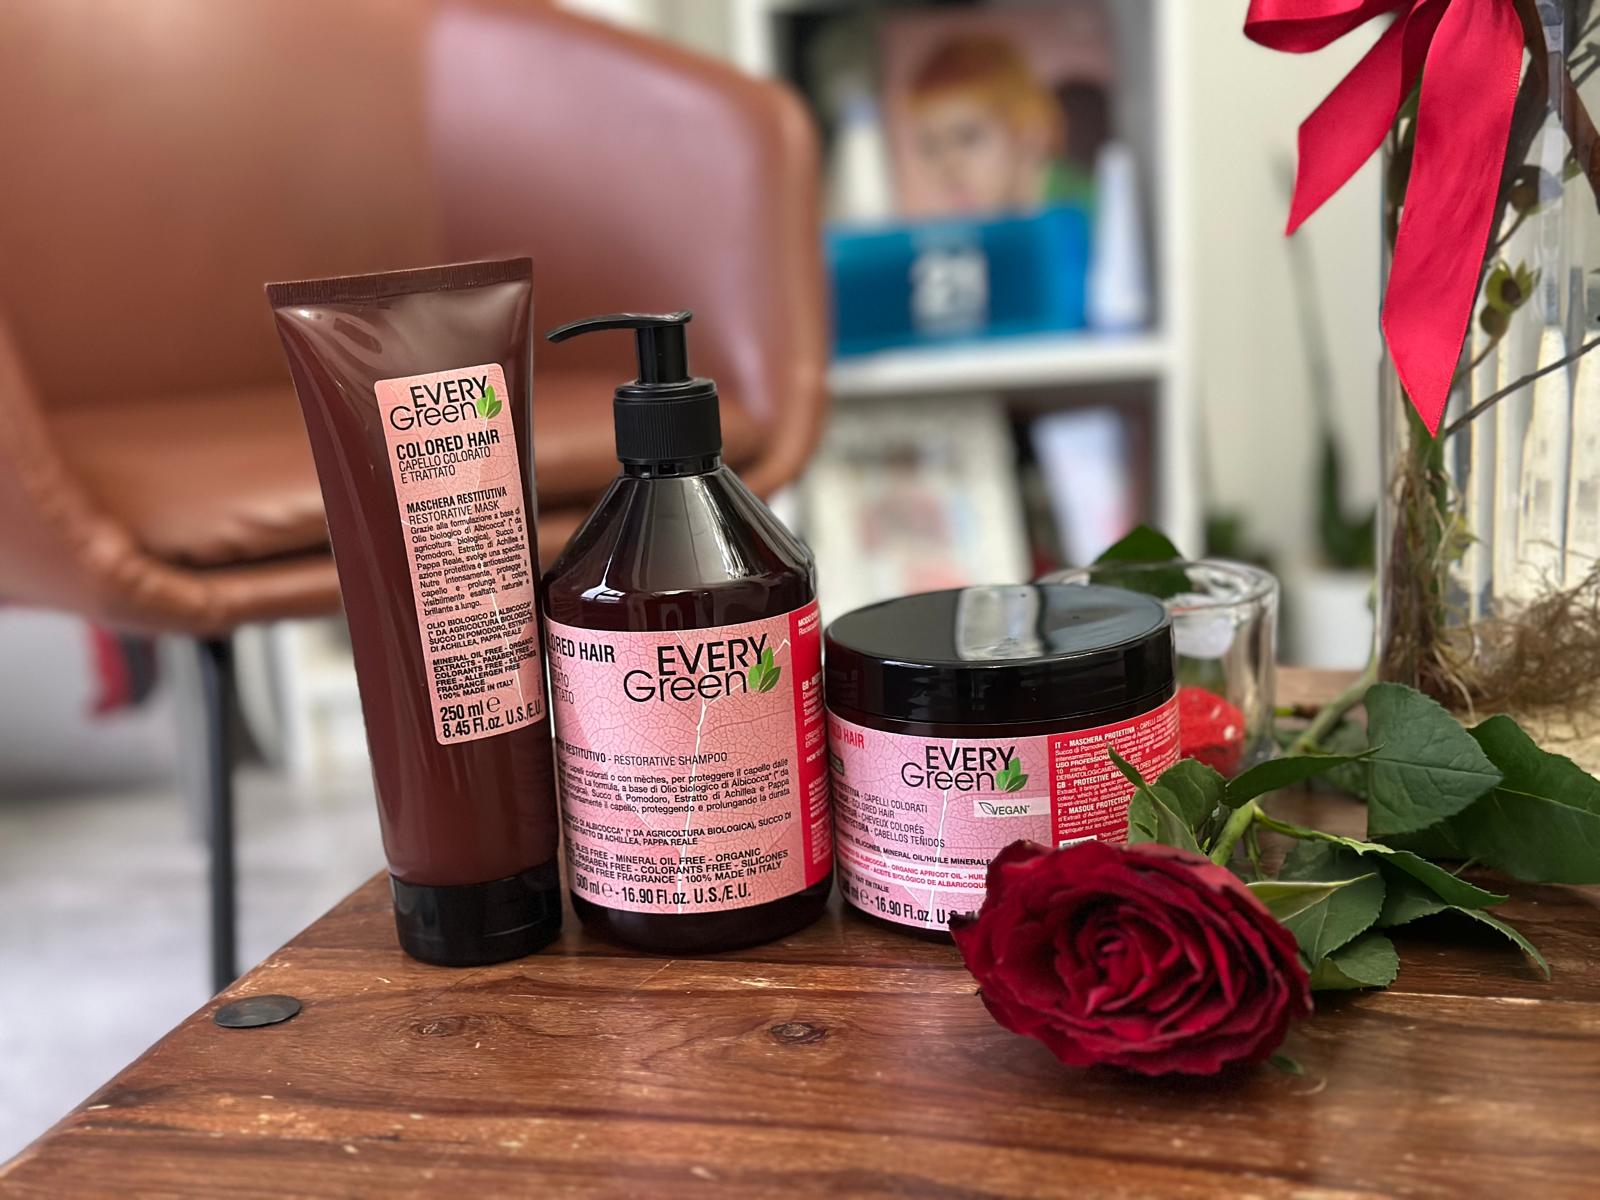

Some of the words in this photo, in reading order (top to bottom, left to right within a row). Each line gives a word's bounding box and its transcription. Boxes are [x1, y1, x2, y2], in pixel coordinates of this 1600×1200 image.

[410, 375, 487, 408] EVERY
[390, 401, 477, 430] Green
[396, 435, 463, 460] COLORED
[467, 429, 500, 448] HAIR
[399, 455, 441, 472] CAPELLO
[443, 446, 490, 464] COLORATO
[400, 473, 408, 484] E
[410, 465, 455, 482] TRATTATO
[407, 496, 455, 514] MASCHERA
[457, 486, 507, 505] RESTITUTIVA
[409, 505, 472, 525] RESTORATIVE
[474, 500, 500, 514] MASK
[411, 525, 433, 535] Grazie
[417, 562, 440, 571] Pappa
[426, 621, 446, 630] OLIO
[448, 612, 488, 627] BIOLOGICO
[436, 629, 448, 637] DA
[450, 618, 500, 634] AGRICOLTURA
[430, 635, 456, 645] SUCCO
[430, 645, 439, 653] DI
[440, 640, 479, 651] ACHILLEA,
[480, 634, 502, 644] PAPPA
[503, 628, 522, 638] REALE
[432, 656, 469, 666] MINERAL
[484, 648, 503, 656] FREE
[434, 660, 476, 673] EXTRACTS
[483, 652, 514, 664] PARABEN
[579, 642, 616, 664] HAIR
[656, 633, 767, 677] EVERY
[435, 666, 483, 680] COLORANTS
[485, 660, 504, 669] FREE
[436, 678, 457, 687] FREE
[465, 669, 504, 682] ALLERGEN
[505, 663, 521, 672] FREE
[436, 679, 485, 693] FRAGRANCE
[438, 692, 460, 701] 100%
[463, 688, 485, 697] MADE
[496, 679, 514, 689] ITALY
[624, 670, 747, 702] Green
[440, 704, 464, 722] 250
[468, 700, 484, 718] ml
[442, 720, 471, 738] 8.45
[844, 729, 865, 750] HAIR
[1070, 735, 1103, 747] MASCHERA
[614, 755, 676, 767] RESTORATIVE
[678, 752, 728, 766] SHAMPOO
[925, 746, 1016, 771] EVERY
[1070, 754, 1110, 767] PROFESSIONA
[672, 776, 686, 785] per
[688, 772, 734, 783] proteggere
[744, 764, 771, 776] capello
[772, 758, 788, 769] dalle
[901, 762, 995, 791] Green
[1074, 774, 1109, 787] PROTECTIVE
[1110, 771, 1123, 779] MAS
[626, 794, 670, 804] Pomodoro,
[674, 794, 708, 803] Estratto
[712, 792, 720, 800] di
[724, 787, 756, 799] Achillea
[768, 778, 790, 790] Pappa
[629, 784, 648, 793] base
[650, 785, 658, 793] di
[660, 785, 678, 793] Olio
[680, 782, 719, 794] biologico
[722, 781, 729, 789] di
[642, 804, 695, 815] proteggendo
[706, 797, 758, 812] prolungando
[768, 788, 790, 800] durata
[864, 793, 889, 807] CAPELLI
[890, 800, 928, 813] COLORATI
[1068, 804, 1095, 814] MASQUE
[879, 809, 895, 819] HAIR
[646, 829, 705, 838] AGRICOLTURA
[758, 814, 784, 827] SUCCO
[784, 812, 792, 820] DI
[890, 824, 925, 835] COLORÉS
[644, 838, 669, 846] PAPPA
[670, 838, 698, 846] REALE
[874, 828, 909, 844] CABELLOS
[910, 834, 946, 848] TEÑIDOS
[590, 849, 608, 860] FREE
[616, 854, 657, 865] MINERAL
[660, 858, 677, 866] OIL
[679, 856, 706, 865] FREE
[716, 848, 761, 861] ORGANIC
[610, 862, 633, 873] FREE
[640, 865, 703, 876] COLORANTS
[706, 862, 732, 873] FREE
[741, 850, 789, 868] SILICONES
[883, 848, 911, 860] MINERAL
[912, 854, 949, 865] OIL/HUILE
[596, 868, 615, 880] FREE
[617, 872, 676, 884] FRAGRANCE
[686, 874, 712, 883] 100%
[715, 870, 745, 881] MADE
[747, 867, 756, 876] IN
[760, 861, 782, 874] ITALY
[576, 872, 588, 891] 500
[590, 881, 600, 895] ml
[622, 886, 654, 904] 16.90
[656, 889, 690, 905] Fl.oz.
[694, 882, 752, 904] U.S./E.U.
[875, 895, 901, 917] 16.90
